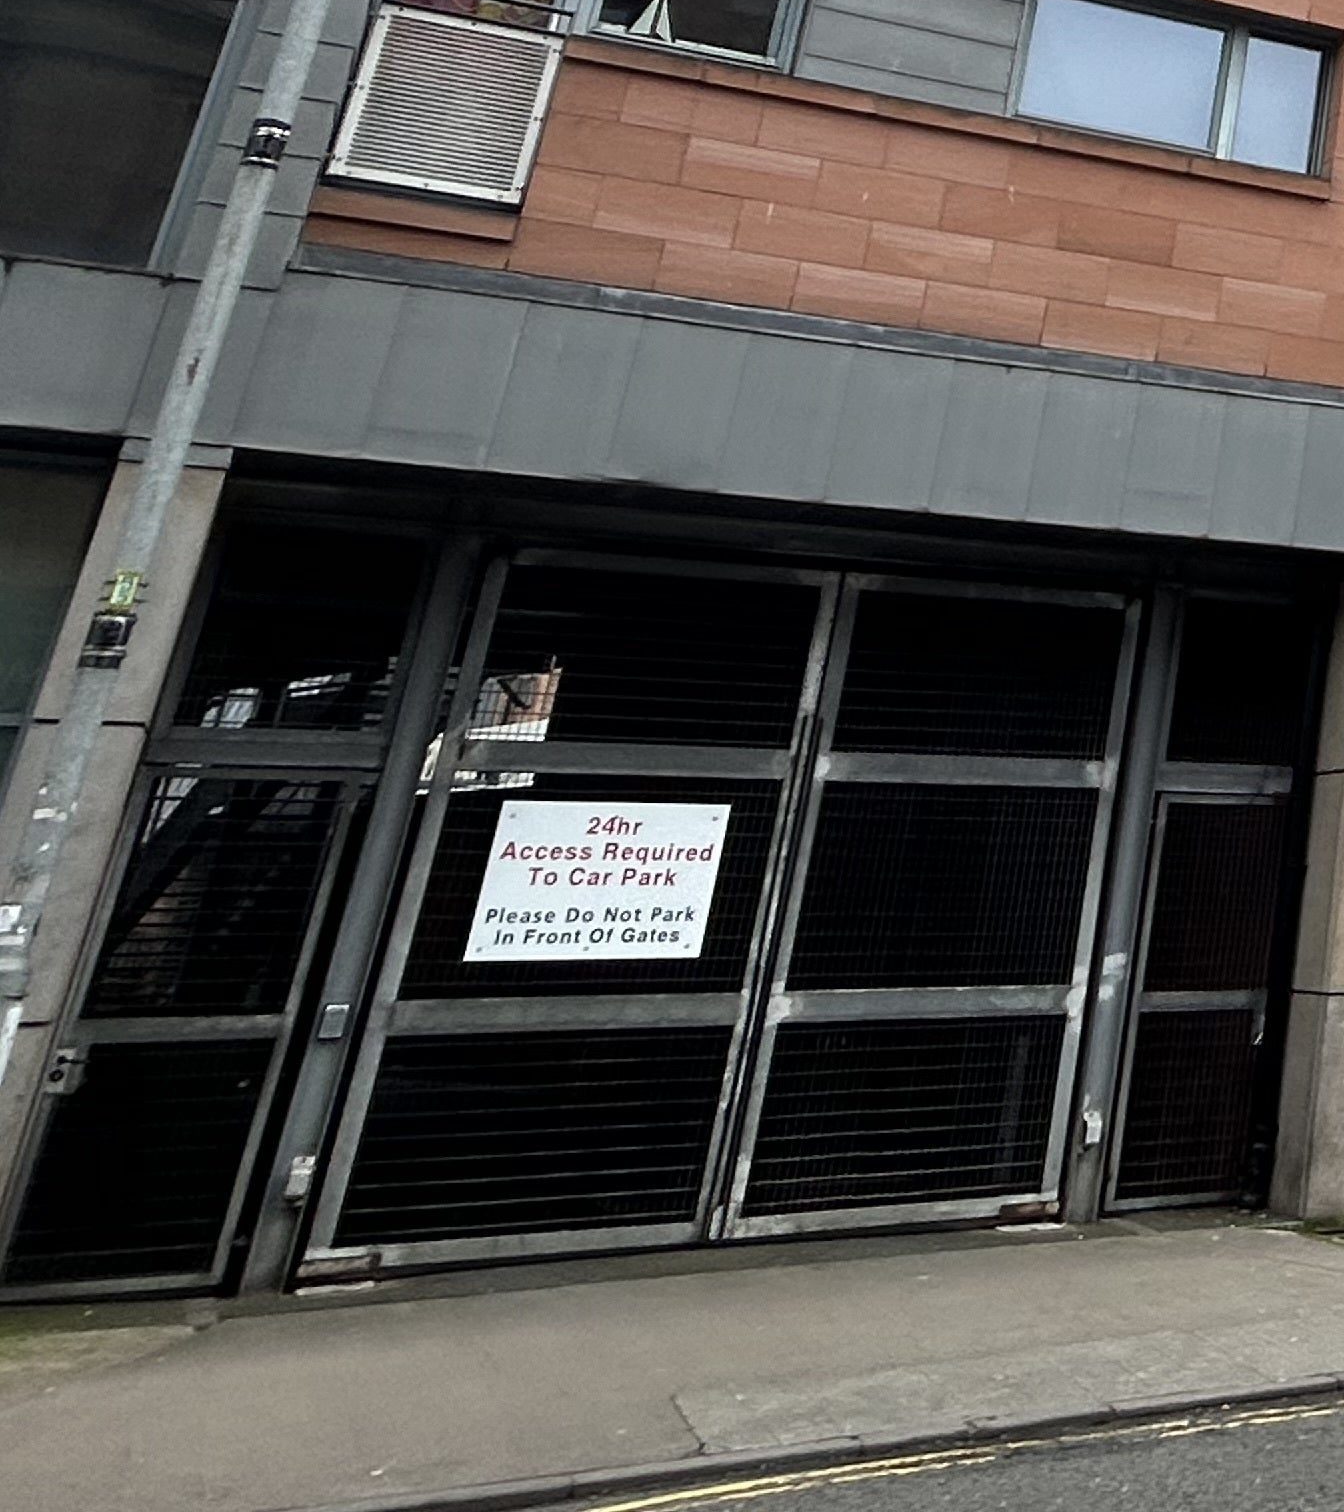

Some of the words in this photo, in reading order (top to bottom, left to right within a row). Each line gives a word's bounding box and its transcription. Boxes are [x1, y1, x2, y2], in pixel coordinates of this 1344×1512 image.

[585, 815, 643, 835] 24hr
[499, 841, 593, 861] Access
[602, 842, 714, 865] Required
[528, 867, 558, 886] To
[568, 867, 613, 886] Car
[620, 868, 678, 886] Park
[484, 907, 556, 924] Please
[564, 907, 594, 924] Do
[603, 906, 642, 922] Not
[650, 905, 695, 922] Park
[493, 929, 514, 945] In
[522, 928, 581, 944] Front
[589, 928, 614, 944] Of
[620, 927, 680, 943] Gates
